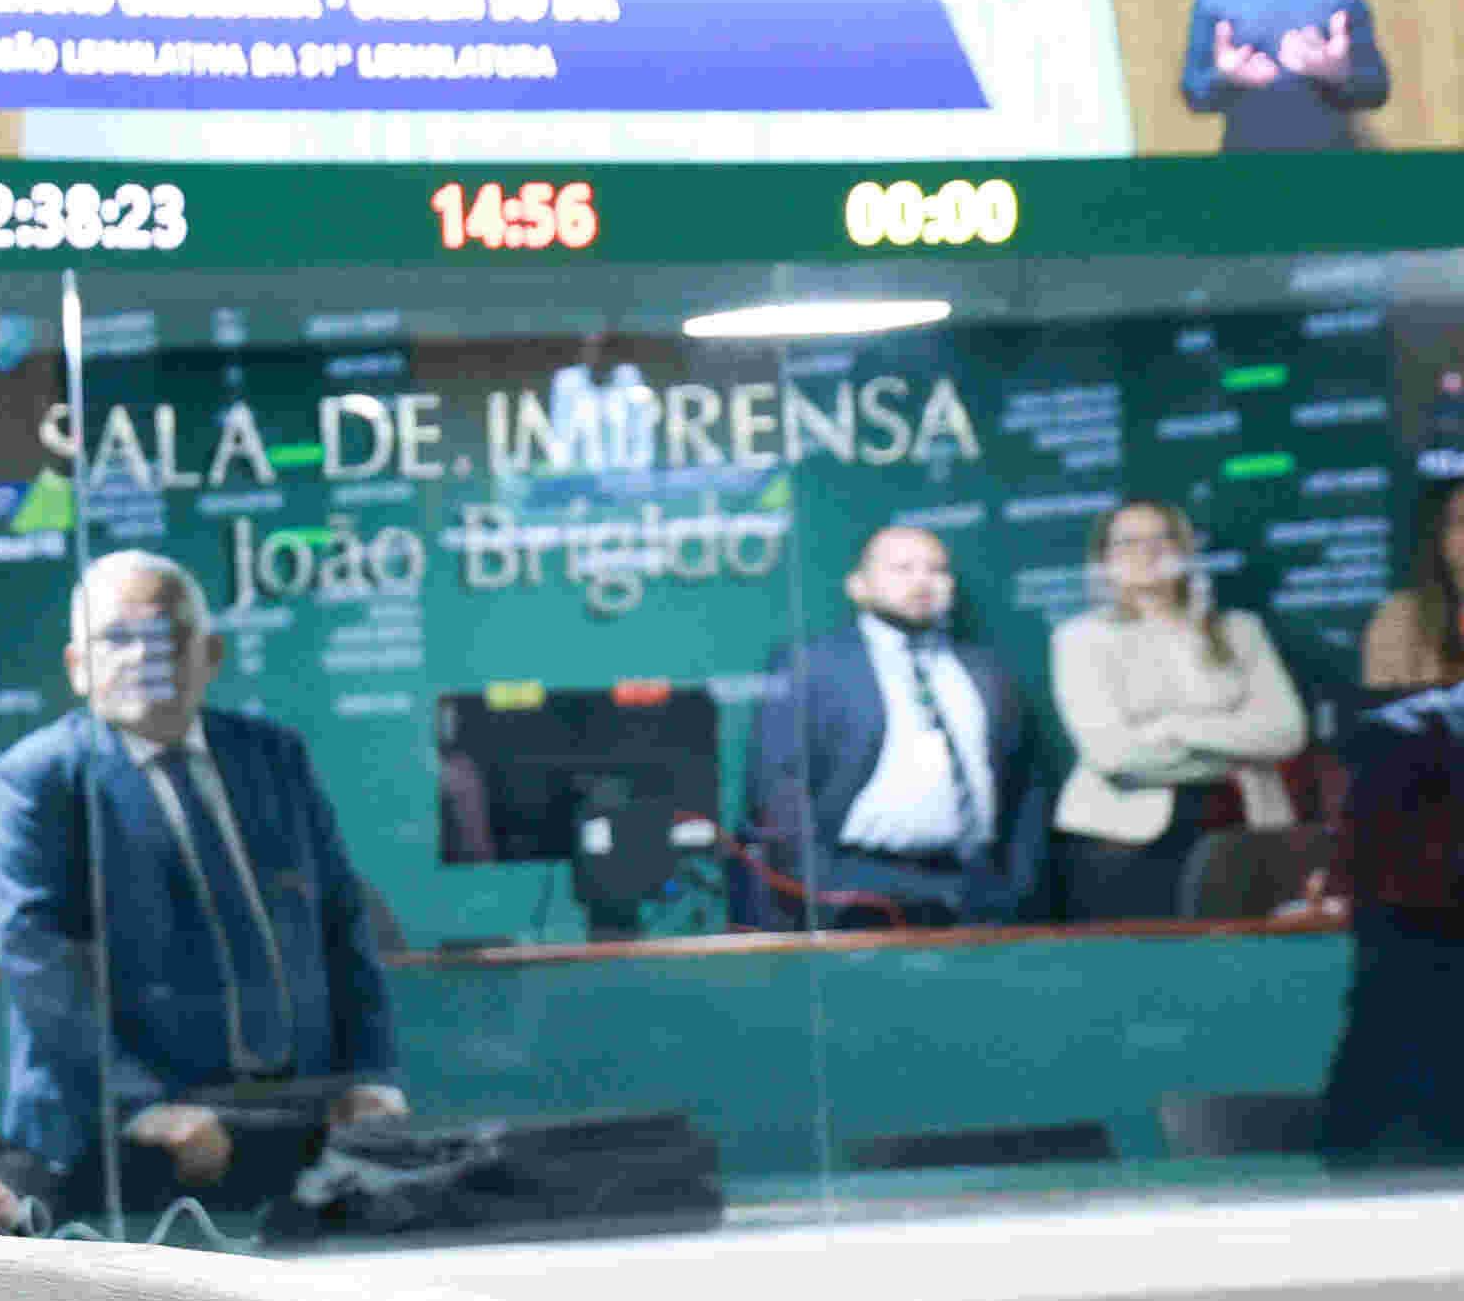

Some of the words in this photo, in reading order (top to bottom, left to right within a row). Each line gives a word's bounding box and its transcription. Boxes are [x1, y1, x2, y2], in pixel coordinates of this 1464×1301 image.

[431, 181, 598, 249] 14:56
[845, 179, 1018, 247] 00:00
[318, 392, 444, 480] DE
[486, 376, 981, 481] IMPRENSA
